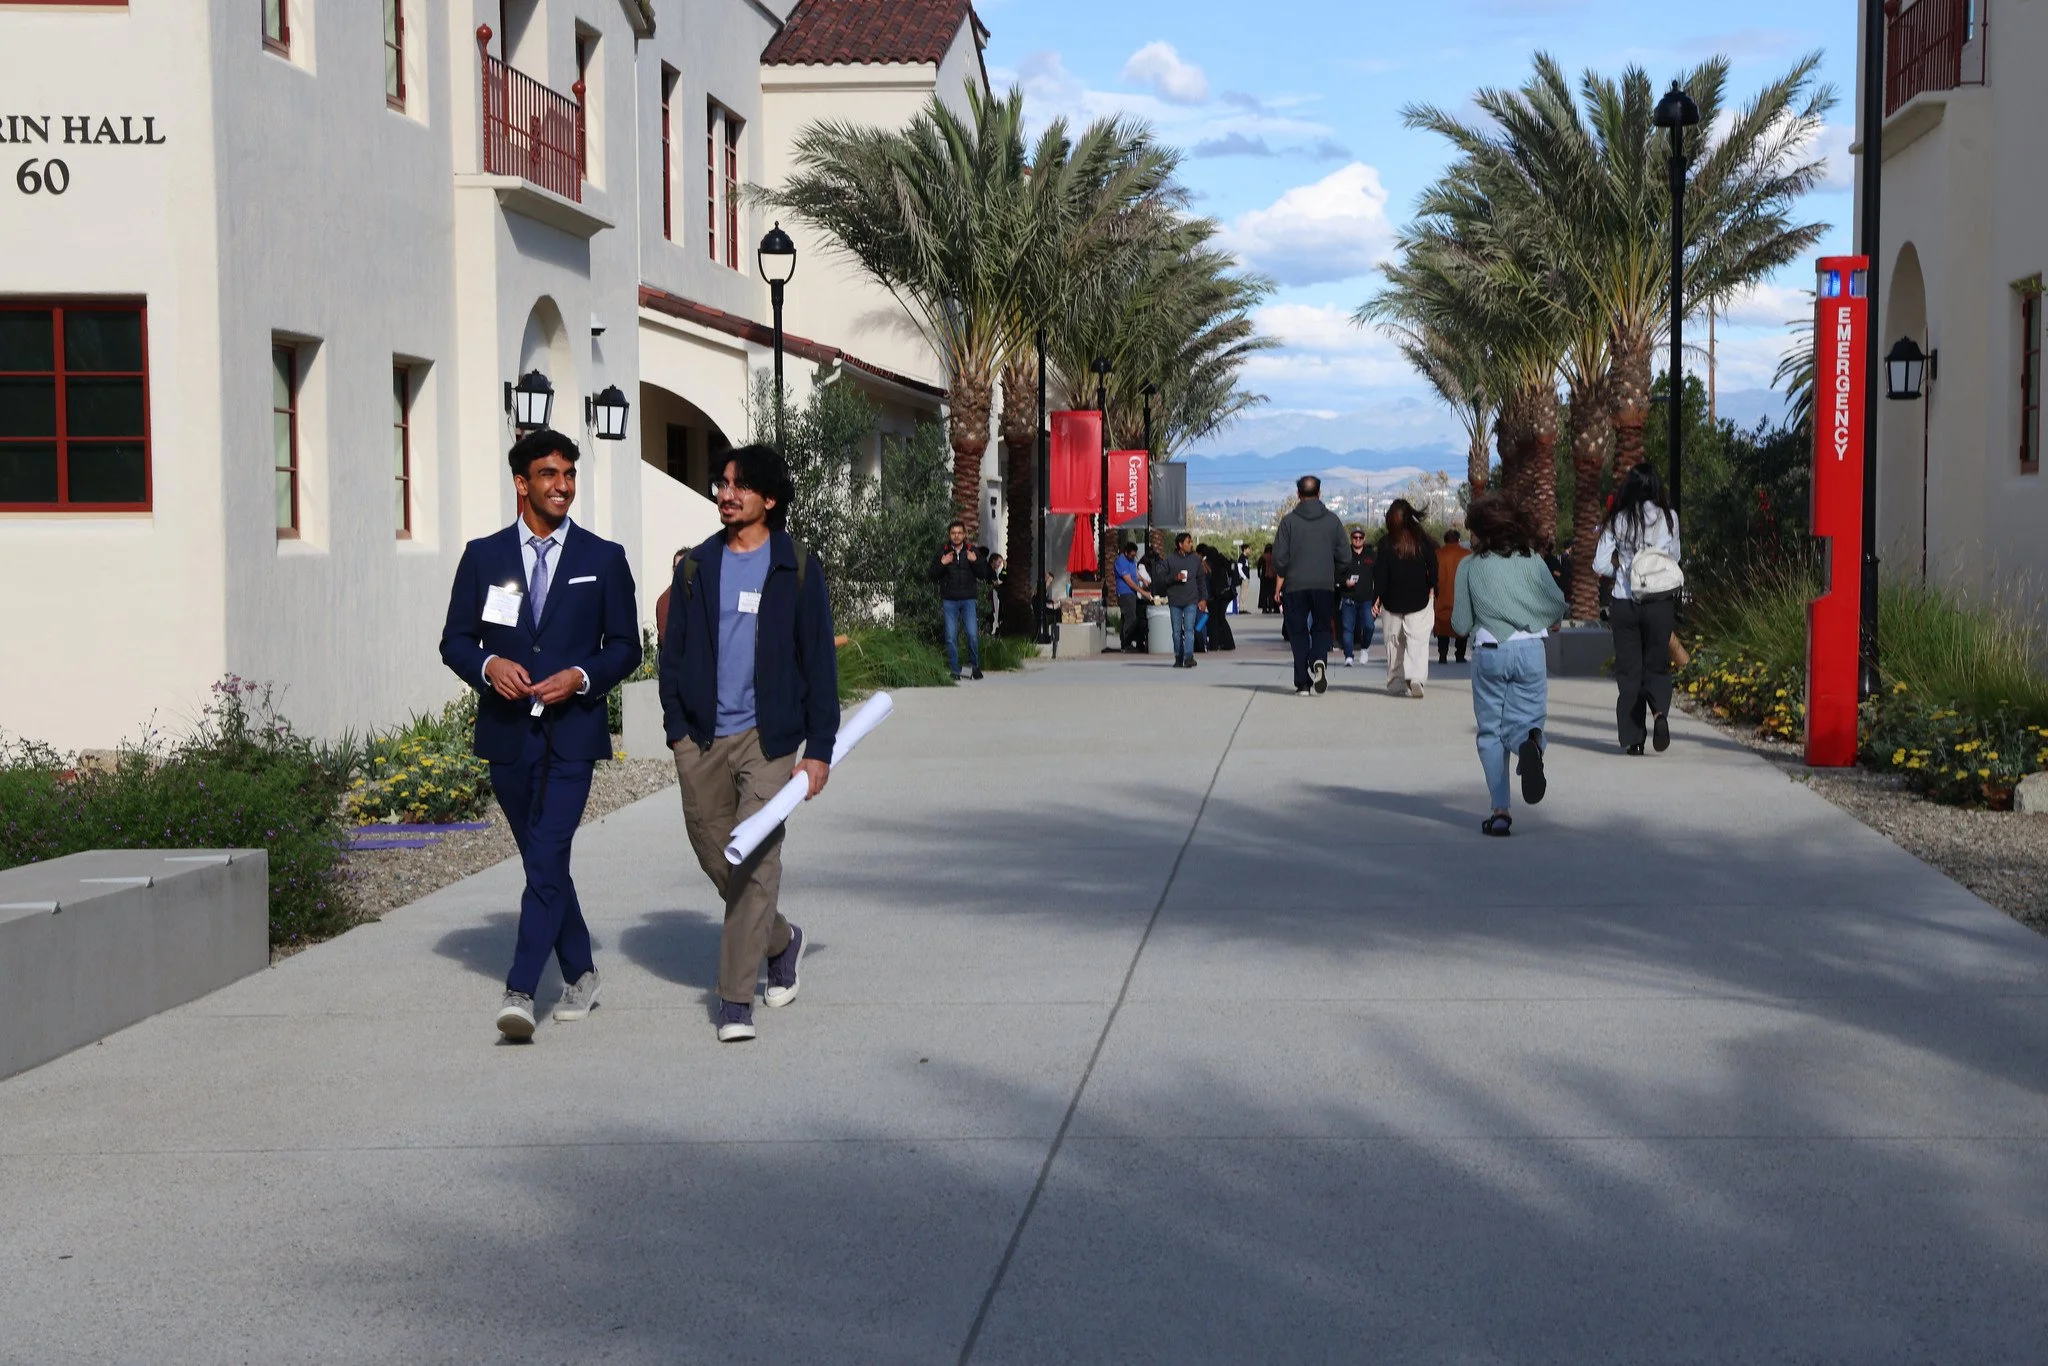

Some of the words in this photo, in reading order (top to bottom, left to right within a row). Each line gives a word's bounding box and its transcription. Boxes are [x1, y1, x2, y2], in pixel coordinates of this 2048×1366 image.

[0, 115, 51, 144] IN
[62, 116, 167, 145] HALL
[16, 158, 70, 195] 60
[1834, 306, 1852, 461] EMERGENCY
[1115, 492, 1125, 513] Hall
[1127, 455, 1142, 514] Gateway
